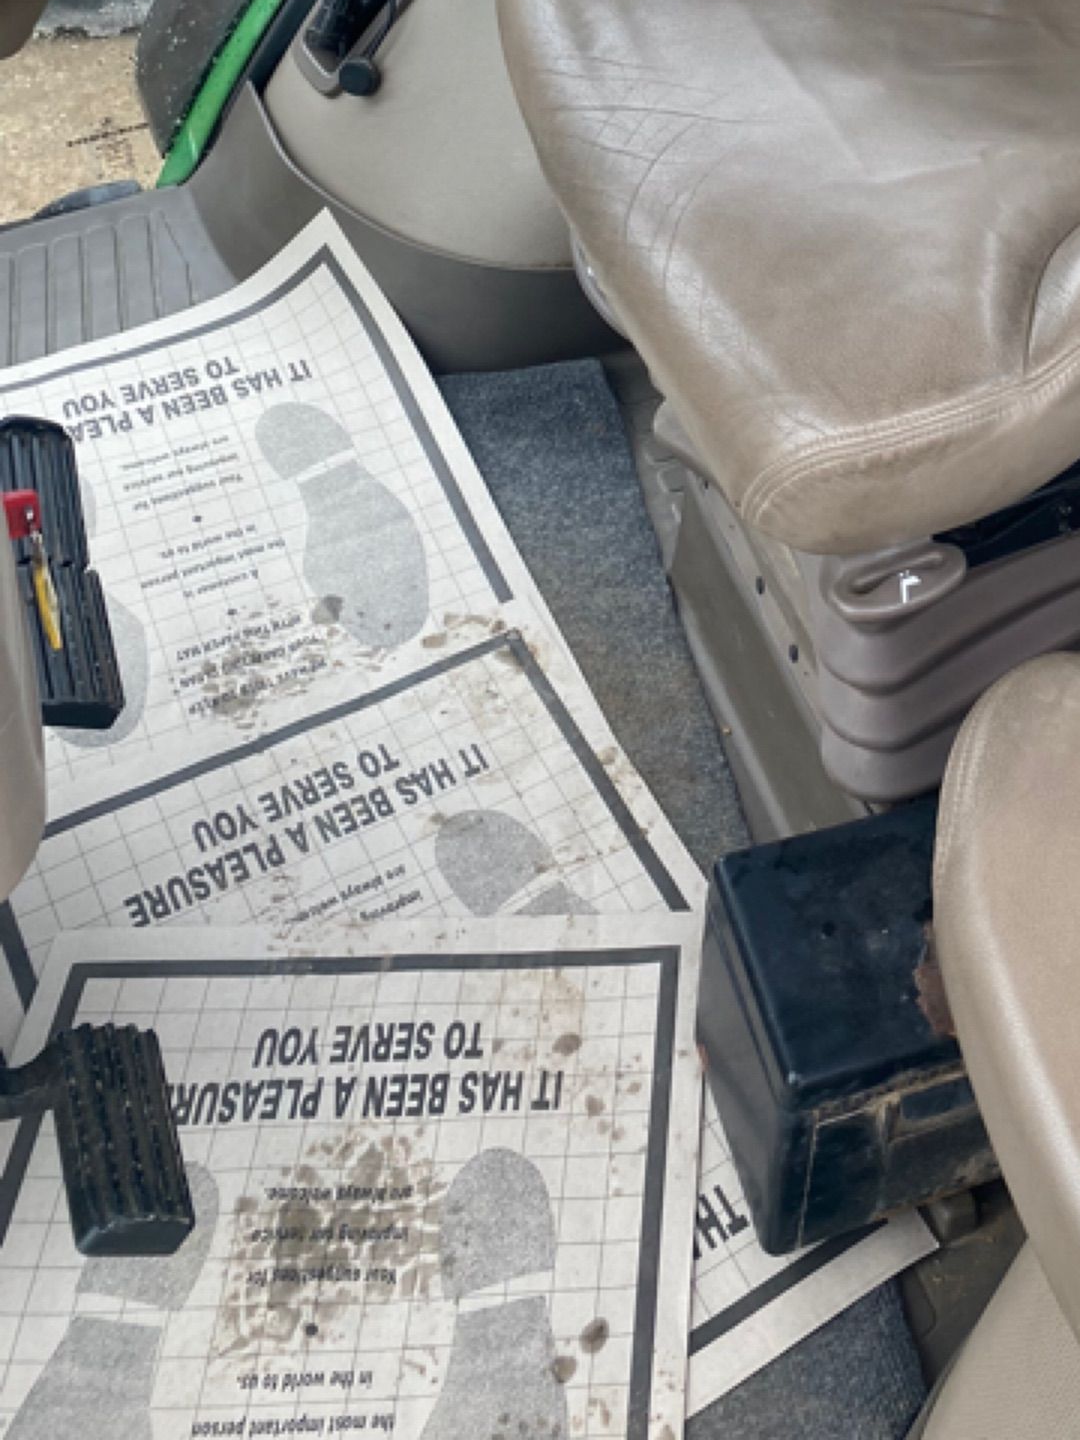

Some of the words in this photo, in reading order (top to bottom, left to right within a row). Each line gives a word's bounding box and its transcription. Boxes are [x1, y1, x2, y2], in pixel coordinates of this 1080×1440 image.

[206, 357, 240, 379] TO
[232, 369, 282, 397] HAS
[289, 360, 312, 382] IT
[120, 369, 199, 404] SERVE
[162, 385, 228, 419] BEEN
[63, 391, 115, 418] YOU
[137, 405, 153, 425] A
[68, 411, 133, 442] PLEA
[358, 744, 400, 778] TO
[459, 744, 489, 777] IT
[258, 762, 354, 822] SERVE
[395, 759, 456, 804] HAS
[193, 805, 259, 852] YOU
[314, 786, 395, 843] BEEN
[285, 822, 309, 853] A
[124, 835, 285, 927] PLEASURE
[253, 1028, 318, 1067] YOU
[330, 1022, 435, 1063] SERVE
[444, 1022, 483, 1059] TO
[336, 1077, 357, 1118] A
[362, 1073, 450, 1118] BEEN
[459, 1071, 523, 1113] HAS
[531, 1070, 563, 1110] IT
[694, 1184, 749, 1259] TH
[245, 1271, 266, 1287] for
[237, 1374, 258, 1389] us.
[264, 1374, 278, 1390] to
[282, 1373, 324, 1392] world
[330, 1370, 354, 1389] the
[359, 1371, 372, 1384] in
[192, 1416, 246, 1437] person
[249, 1414, 324, 1438] important
[328, 1416, 366, 1432] most
[372, 1414, 395, 1431] the
